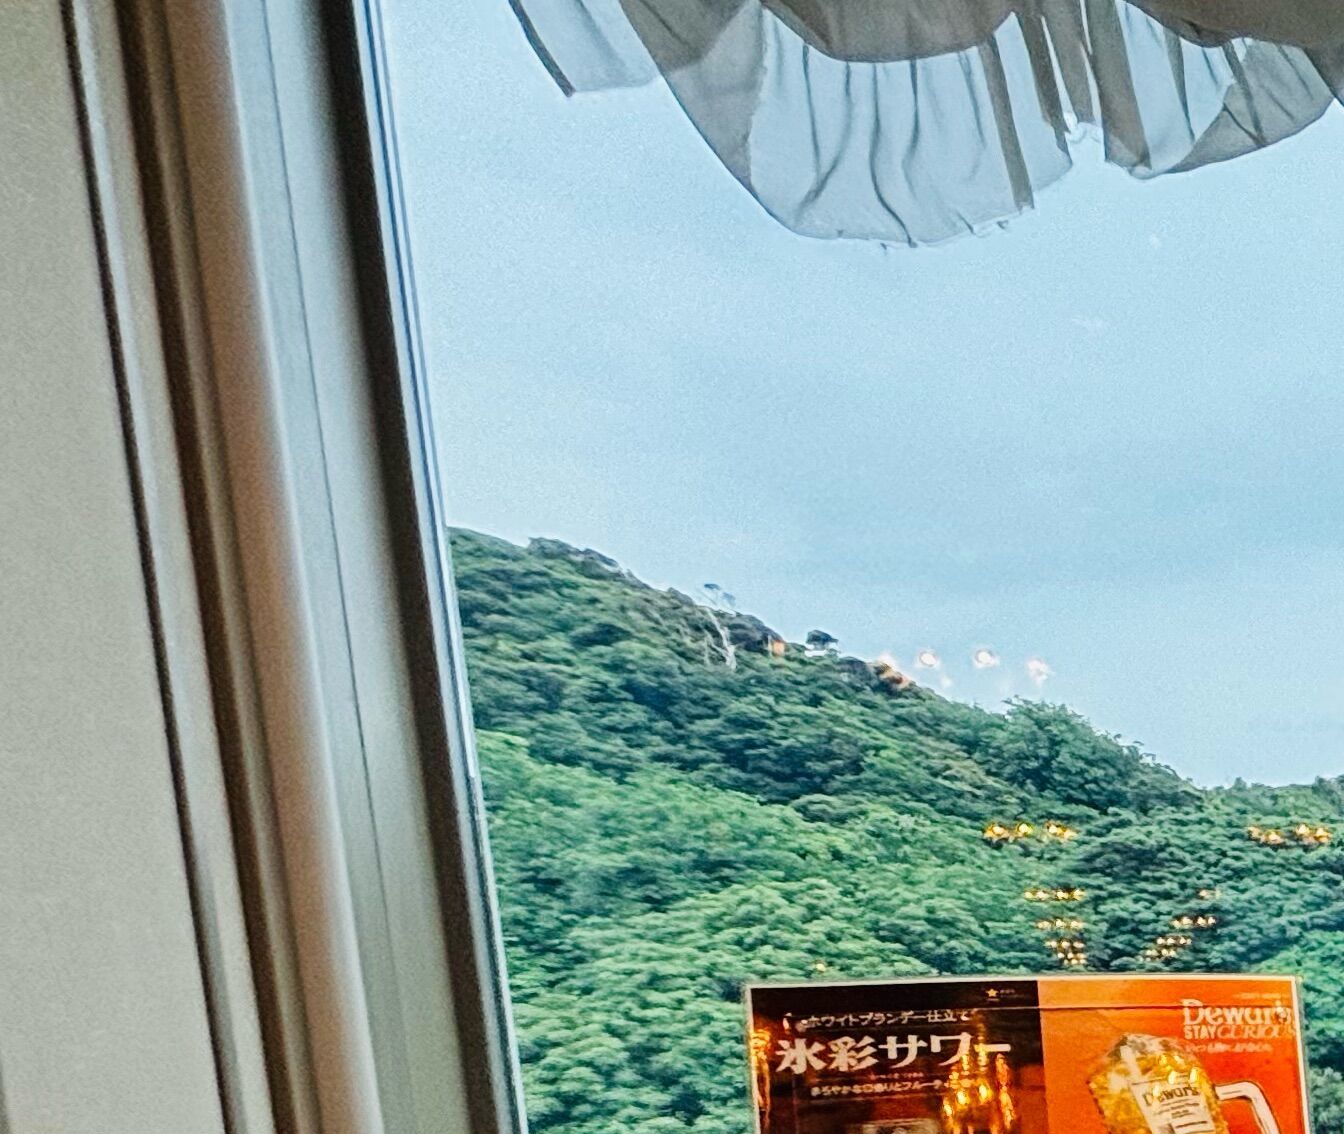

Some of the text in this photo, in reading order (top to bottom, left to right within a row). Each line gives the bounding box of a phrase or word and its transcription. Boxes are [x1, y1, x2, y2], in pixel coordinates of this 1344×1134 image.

[1184, 1025, 1216, 1039] STAY
[776, 1031, 1012, 1075] 氷彩サワー
